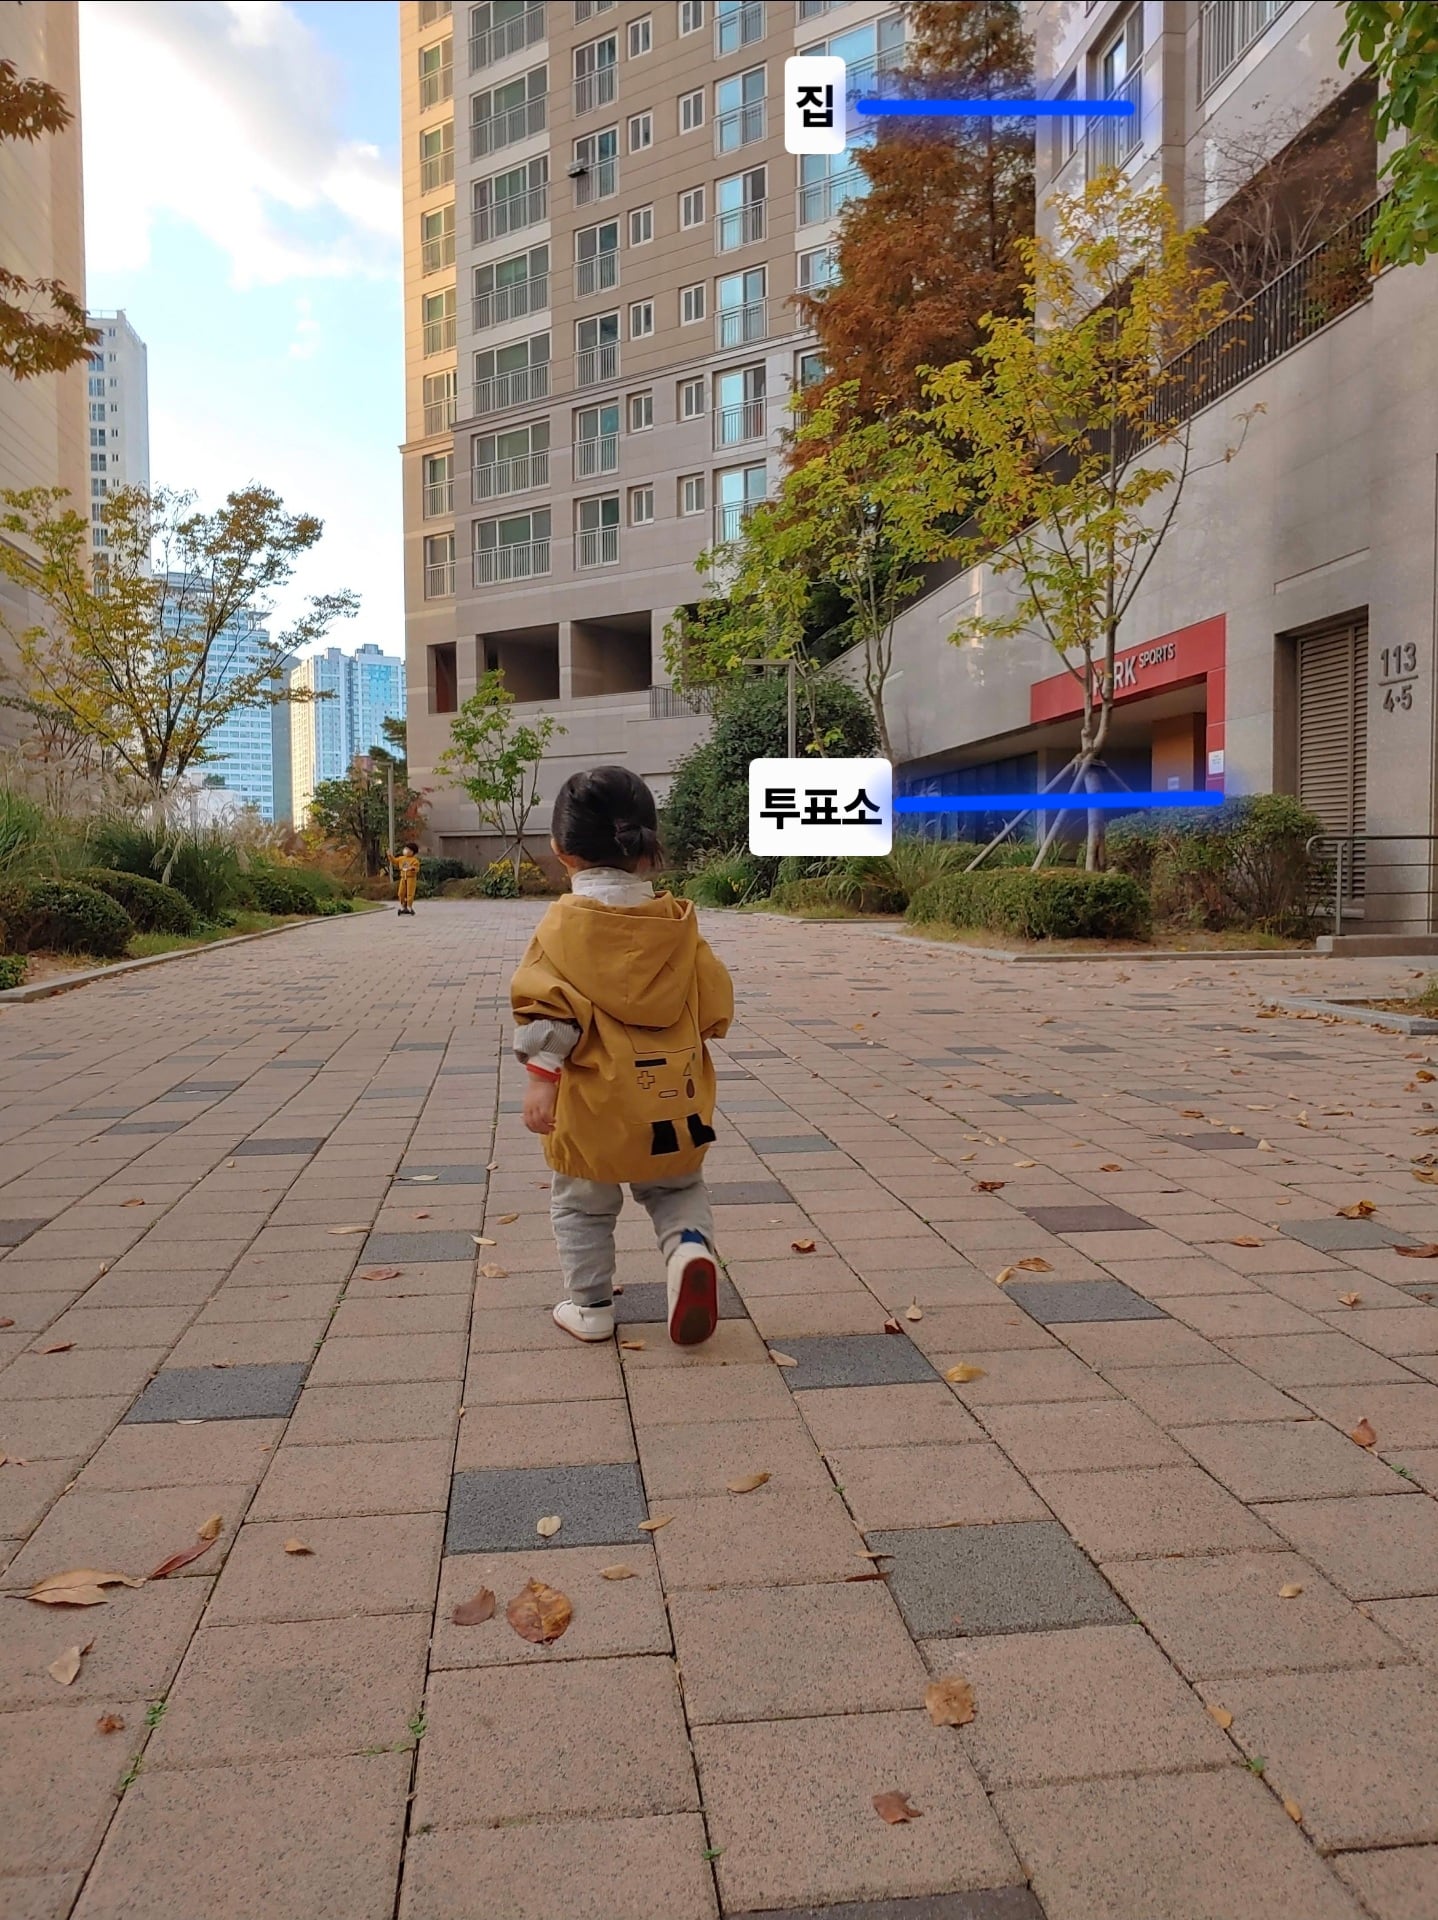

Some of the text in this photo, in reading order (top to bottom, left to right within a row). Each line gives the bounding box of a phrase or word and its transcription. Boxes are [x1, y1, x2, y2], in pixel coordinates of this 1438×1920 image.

[1092, 643, 1176, 697] PRK SPORTS
[1381, 642, 1417, 677] 113
